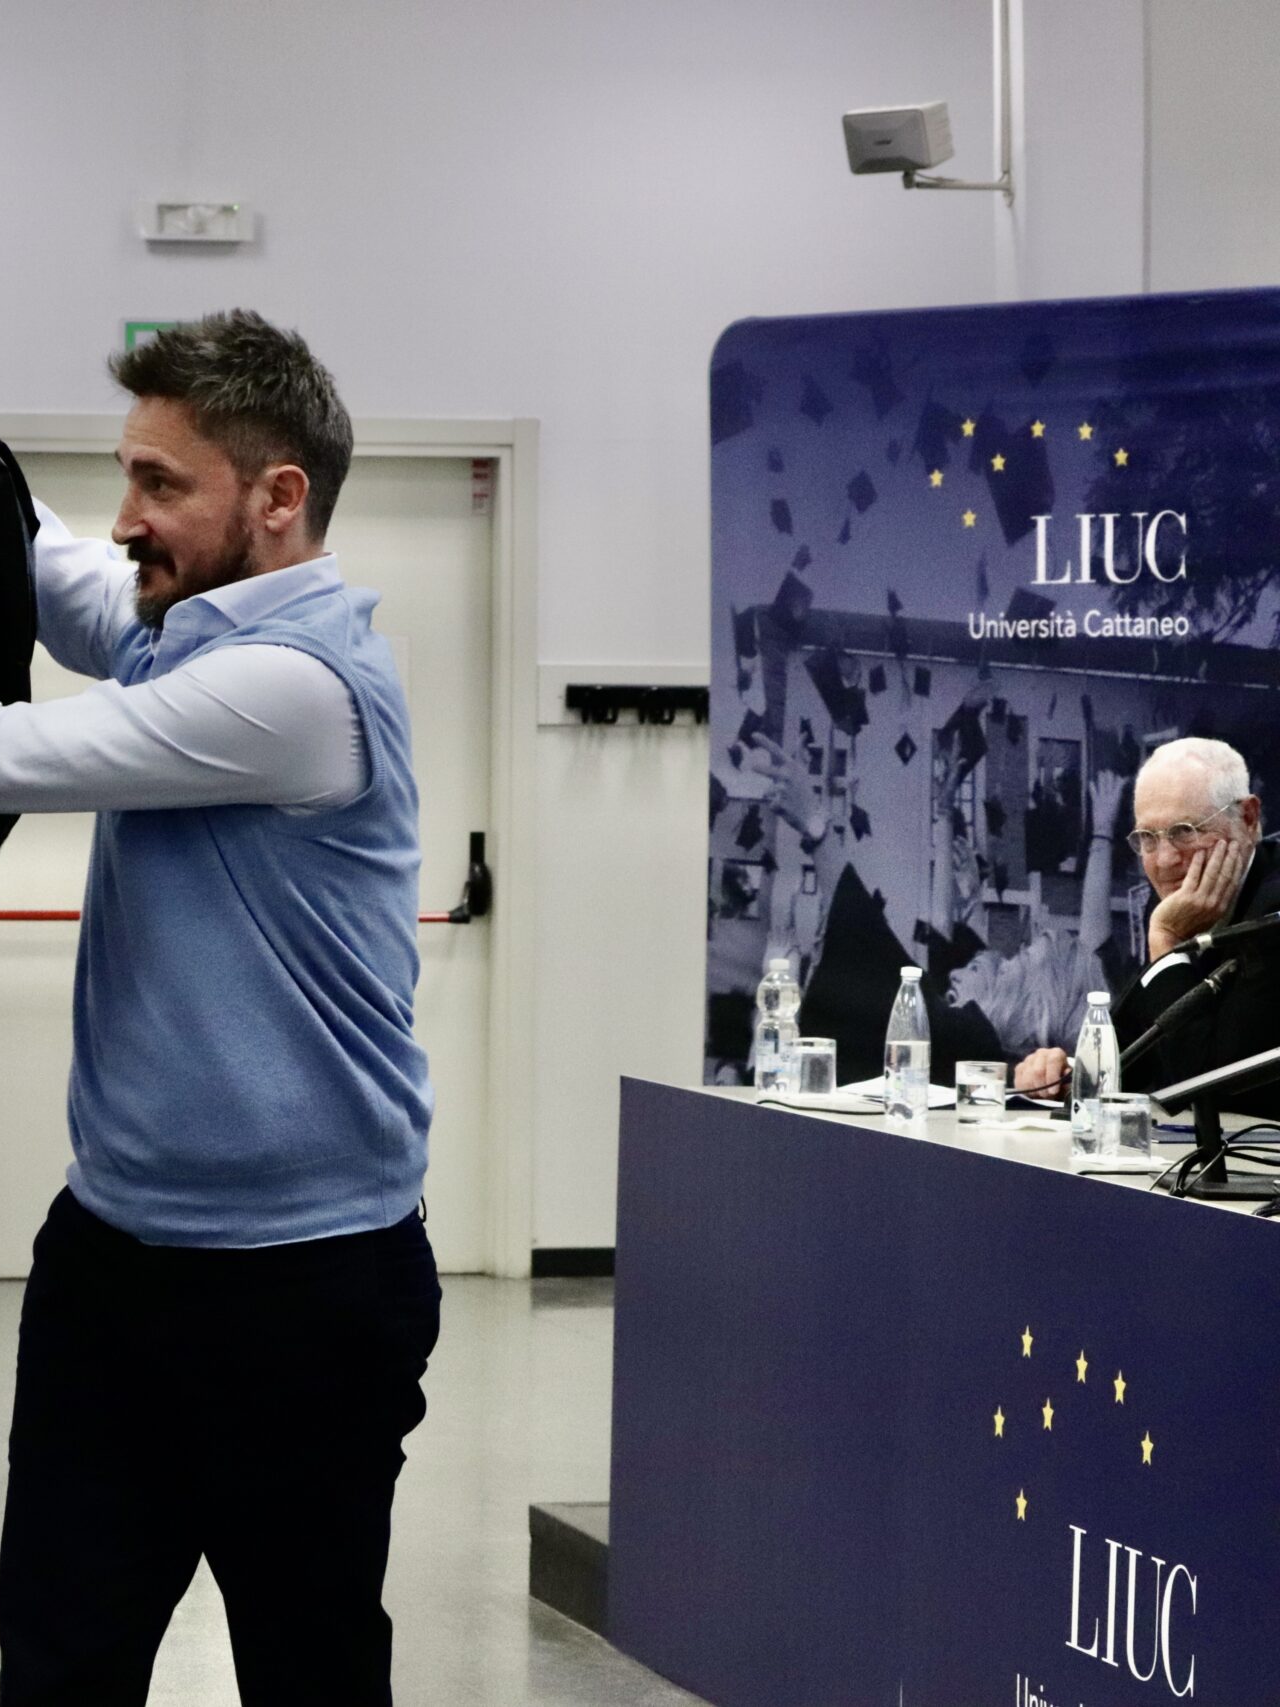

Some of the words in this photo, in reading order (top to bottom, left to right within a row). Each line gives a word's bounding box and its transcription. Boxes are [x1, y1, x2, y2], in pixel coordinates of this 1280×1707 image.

[1030, 510, 1187, 585] LIUC
[968, 610, 1077, 640] Università
[1083, 609, 1190, 638] Cattaneo
[1065, 1524, 1197, 1698] LIUC
